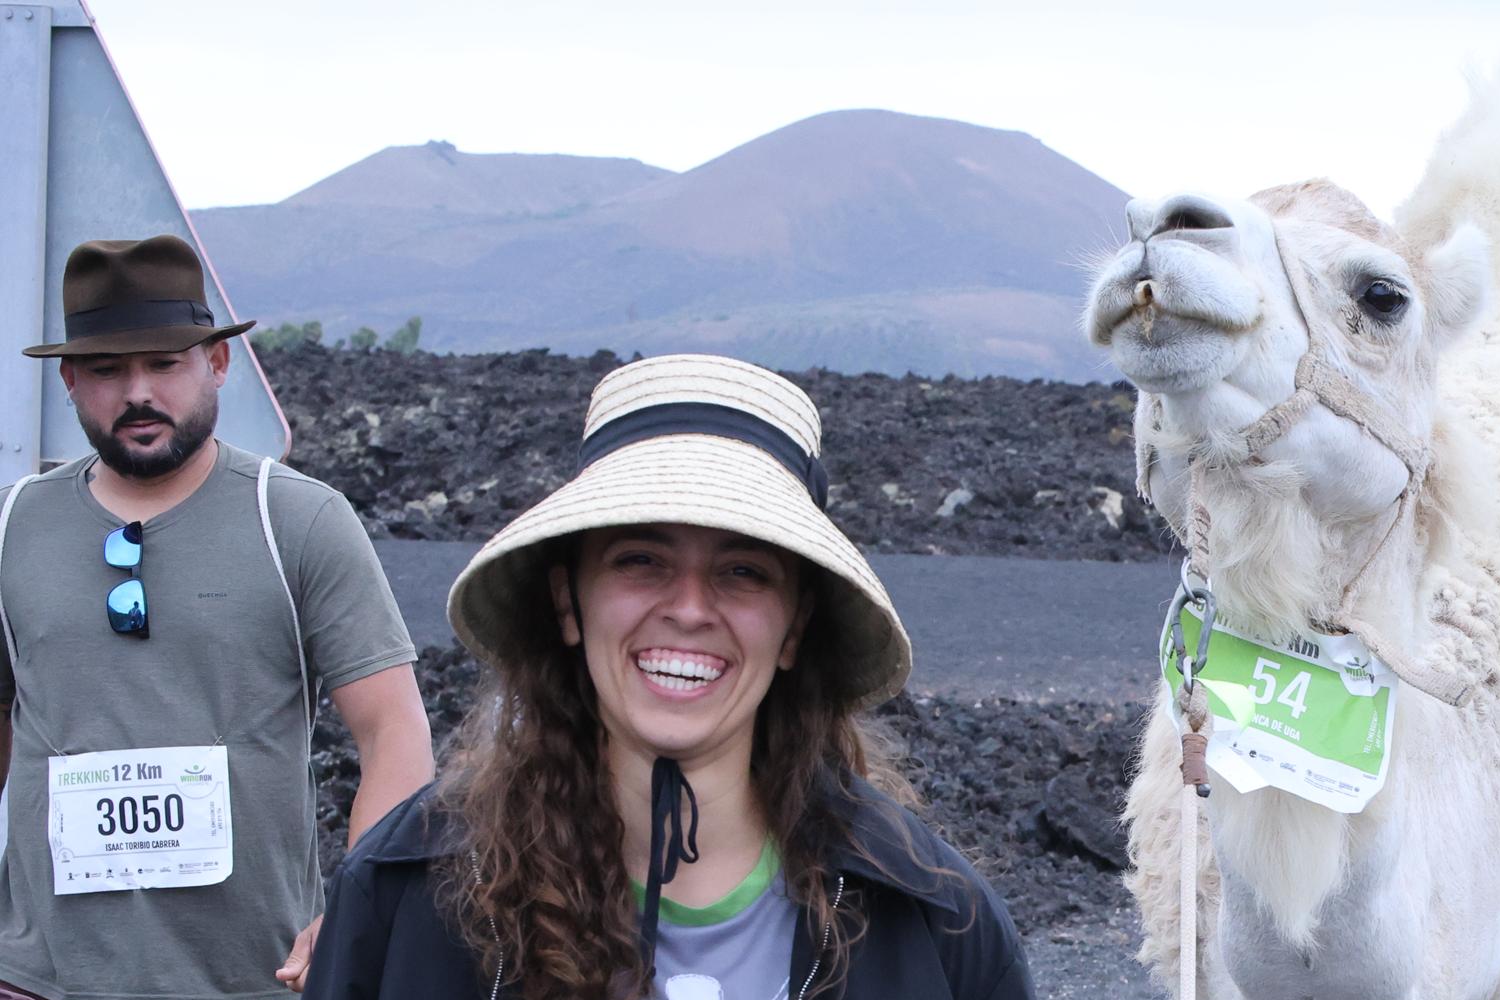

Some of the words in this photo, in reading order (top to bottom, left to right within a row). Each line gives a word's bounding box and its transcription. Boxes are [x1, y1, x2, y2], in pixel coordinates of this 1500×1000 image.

[1249, 656, 1313, 720] 54
[1271, 719, 1283, 733] DE
[1283, 724, 1301, 741] UGA
[58, 769, 110, 787] TREKKING
[112, 764, 131, 782] 12
[137, 762, 162, 780] Km
[96, 793, 185, 836] 3050
[105, 842, 124, 852] ISAAC
[125, 840, 150, 851] TORIBIO
[152, 839, 180, 849] CABRERA
